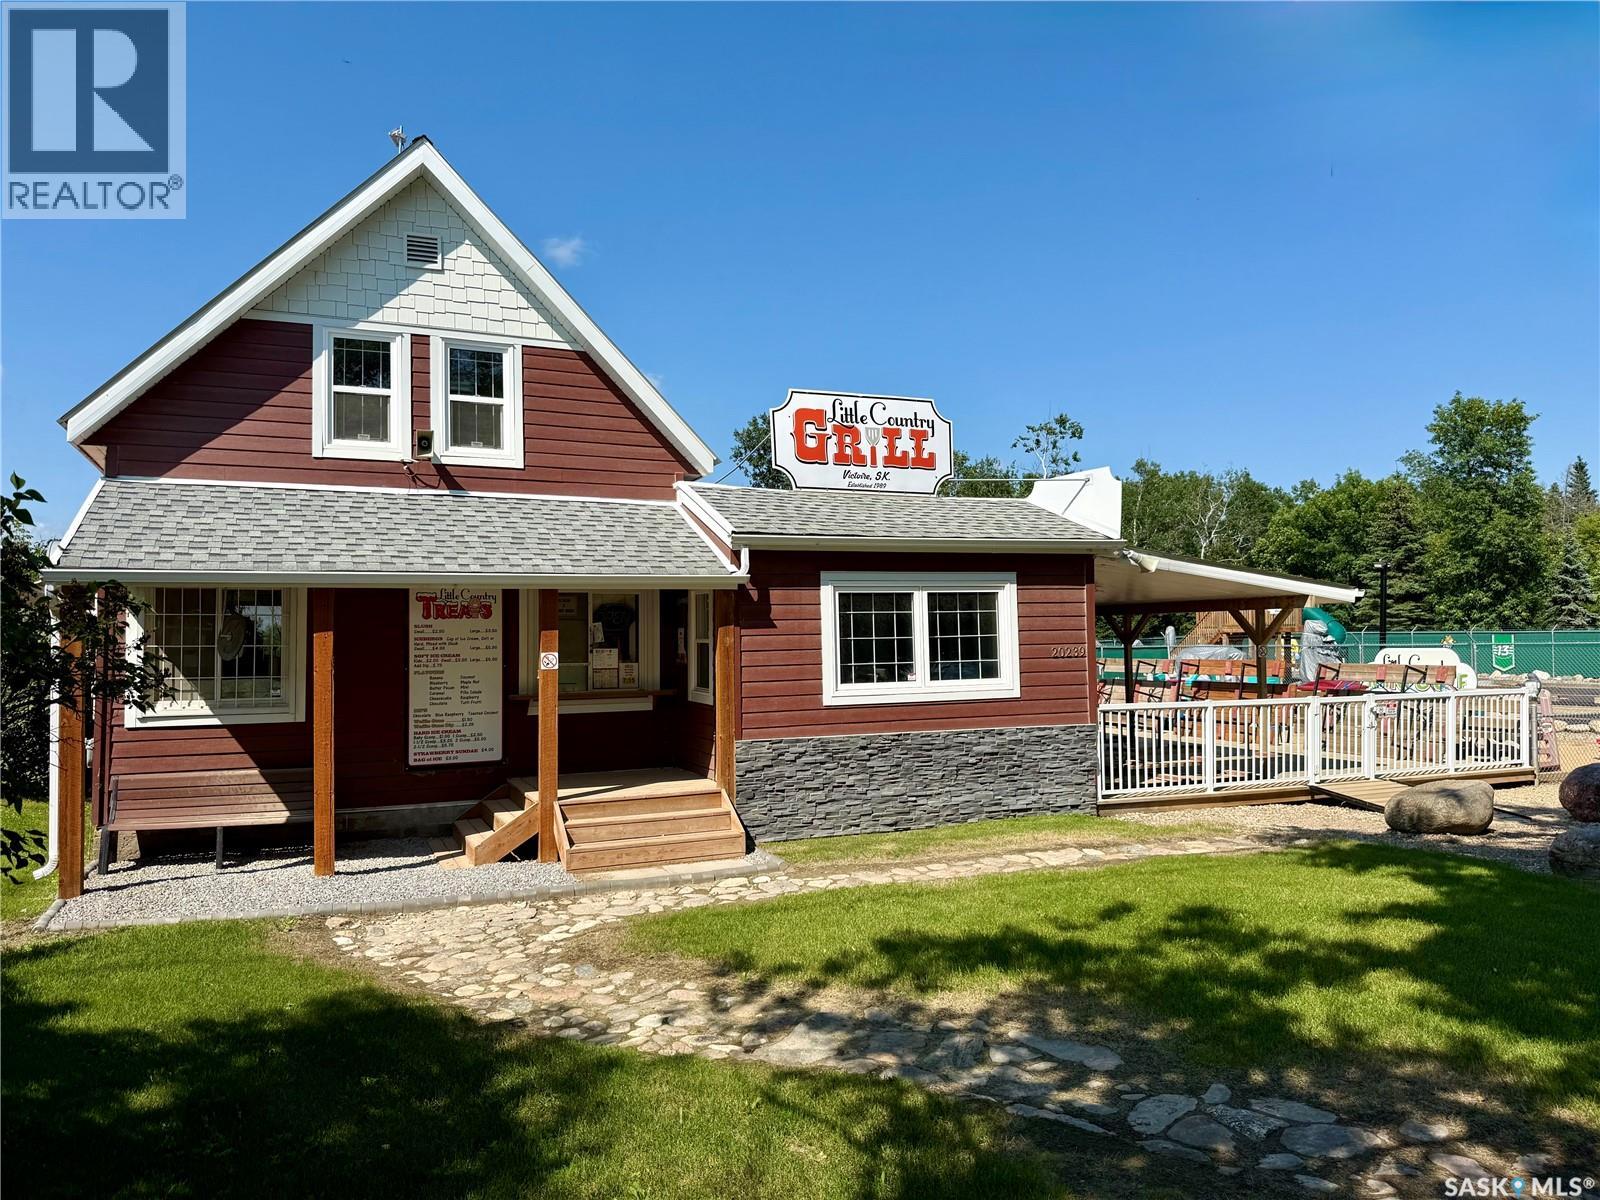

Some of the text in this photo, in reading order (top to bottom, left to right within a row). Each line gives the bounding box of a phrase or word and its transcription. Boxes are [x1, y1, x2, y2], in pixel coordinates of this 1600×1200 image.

[827, 398, 935, 437] Little Country
[790, 408, 937, 470] GRILL
[438, 588, 497, 604] Little Country
[1497, 645, 1510, 656] 13
